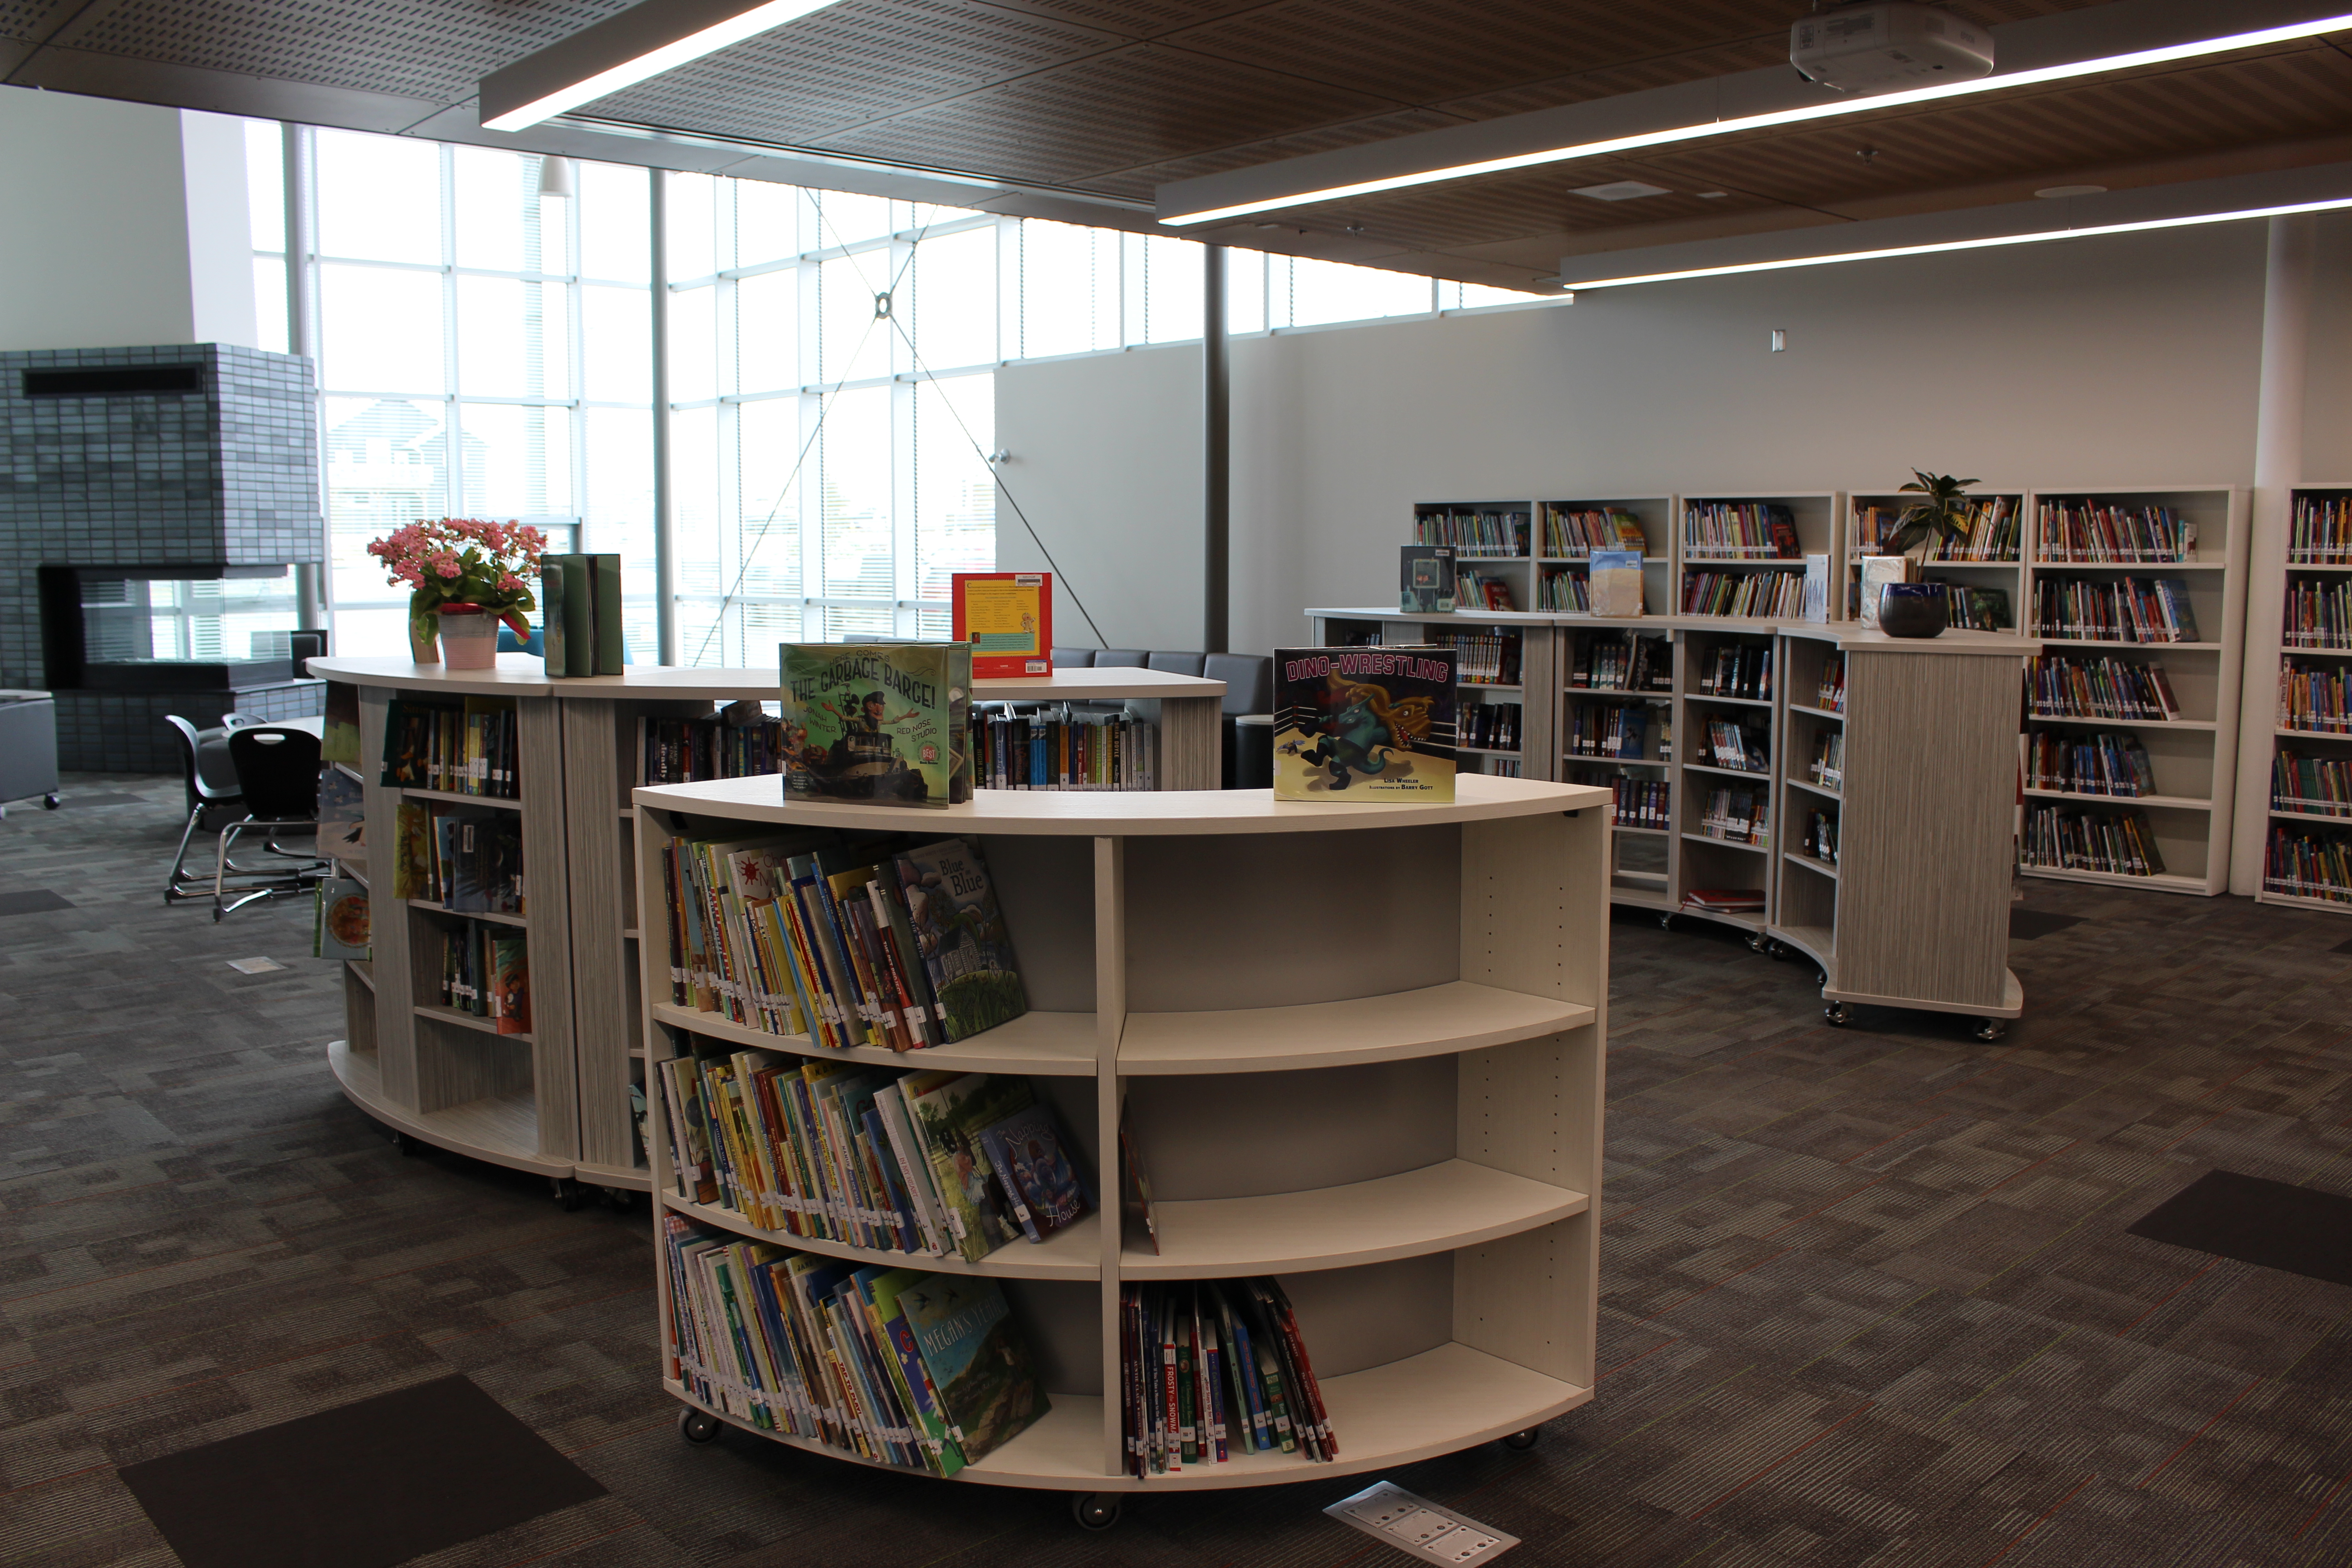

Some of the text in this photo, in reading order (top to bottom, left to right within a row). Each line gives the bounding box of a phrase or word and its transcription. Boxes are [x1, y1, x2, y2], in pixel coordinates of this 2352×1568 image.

[830, 650, 890, 666] HERE COMES
[1286, 654, 1448, 682] DINO-WRESTLING
[790, 657, 935, 710] THE GARBAGE BARGE!
[804, 706, 827, 722] JONAH
[809, 718, 837, 733] WINTER
[912, 719, 931, 732] NOSE
[911, 728, 936, 742] STUDIO
[922, 749, 935, 759] BEST
[939, 858, 964, 876] Blue
[951, 875, 984, 897] Blue
[806, 948, 814, 964] Hand
[812, 970, 821, 985] Hand
[870, 962, 884, 1000] DINO-BOARDING
[890, 967, 902, 995] PROJECT
[725, 1123, 734, 1151] NANETTE'S
[732, 1151, 740, 1176] BAGUETTE
[808, 1133, 816, 1148] Where
[842, 1146, 851, 1167] NANUK
[777, 1171, 782, 1180] On
[855, 1156, 863, 1171] GOOD
[859, 1173, 868, 1191] PIRATE
[902, 1166, 910, 1175] MY
[906, 1176, 918, 1198] HEART
[996, 1123, 1080, 1226] The Napping House
[1000, 1174, 1014, 1198] Napping
[797, 1261, 813, 1272] JANE
[923, 1312, 973, 1356] MEGAN'S
[971, 1295, 1002, 1326] YEAR
[839, 1362, 862, 1415] TAP TO PLAY!
[1288, 1361, 1297, 1377] Knocking
[1295, 1383, 1304, 1401] Christmas
